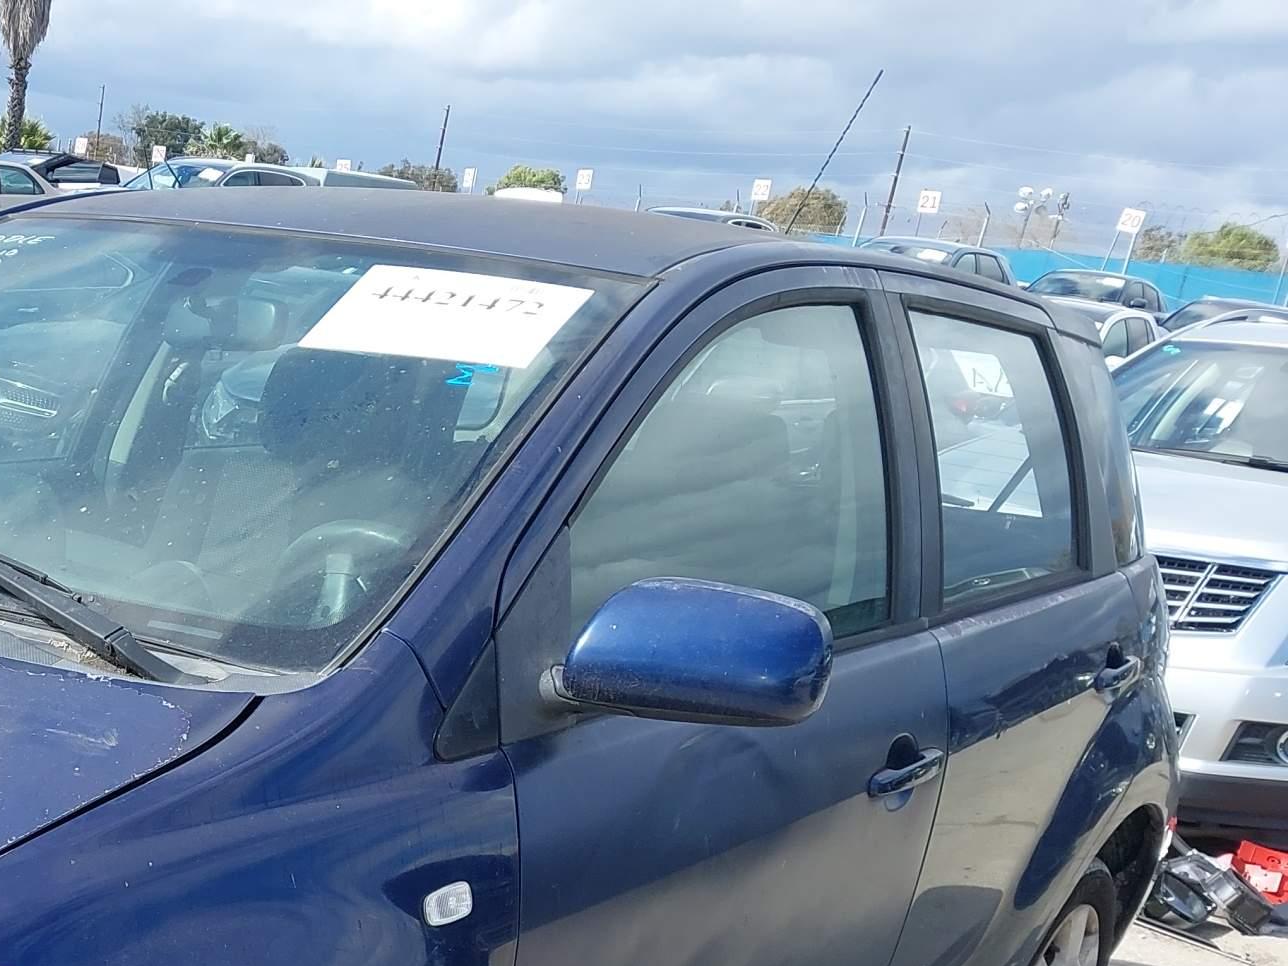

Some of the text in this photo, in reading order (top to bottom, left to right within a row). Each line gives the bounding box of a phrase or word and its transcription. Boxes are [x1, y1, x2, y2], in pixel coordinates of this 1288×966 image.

[920, 195, 937, 208] 21
[1121, 213, 1142, 228] 20
[370, 285, 545, 316] 44421472
